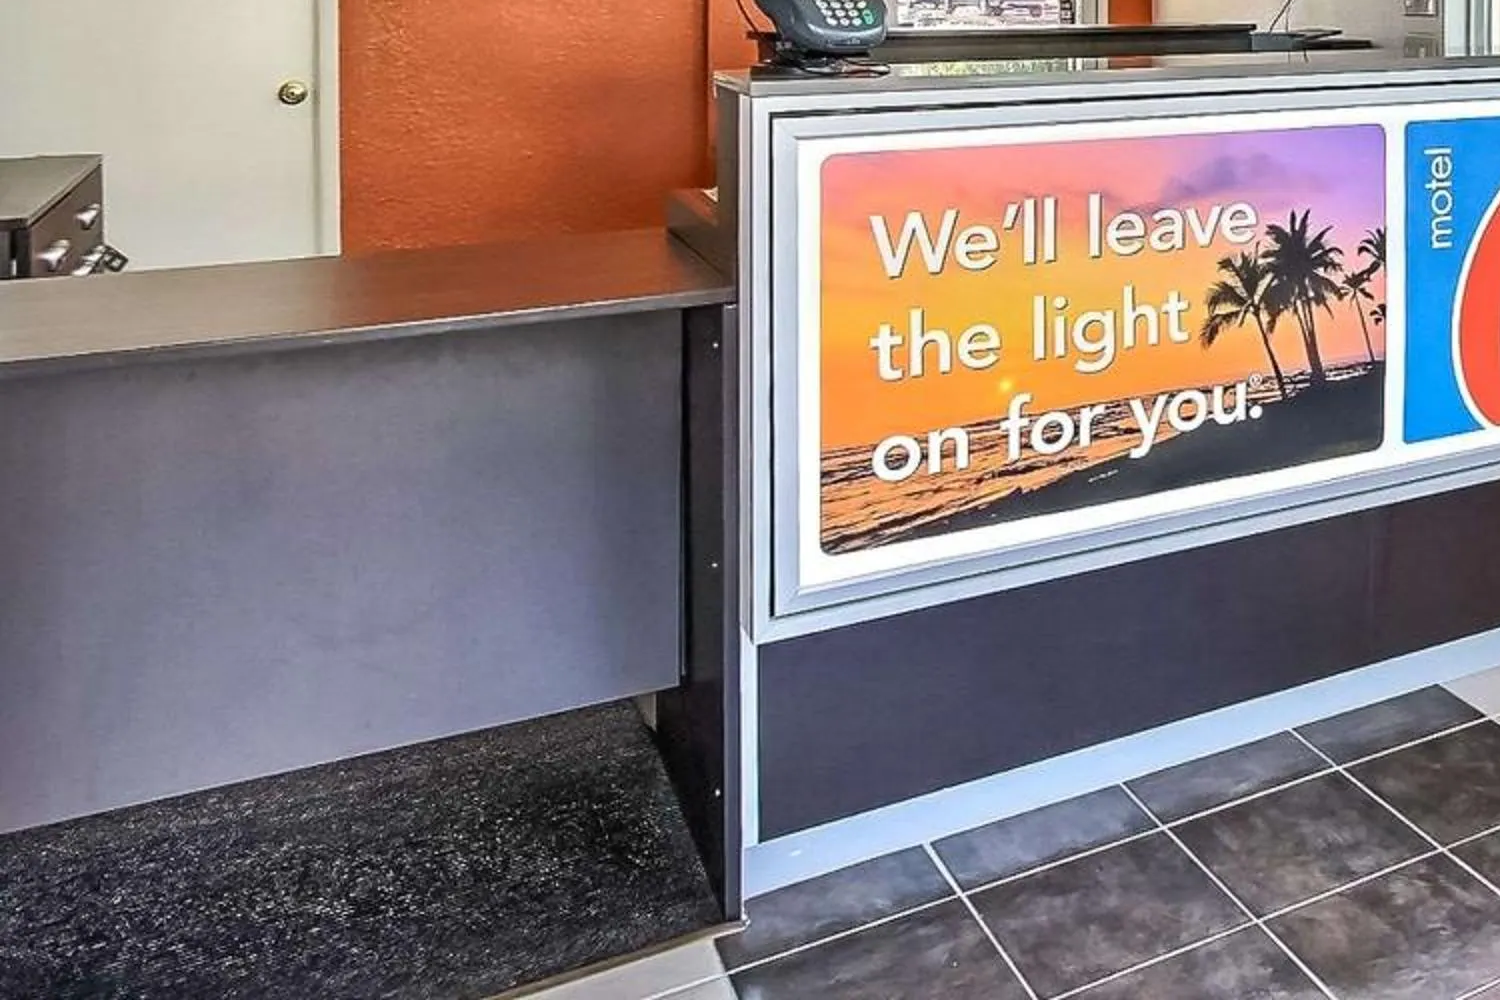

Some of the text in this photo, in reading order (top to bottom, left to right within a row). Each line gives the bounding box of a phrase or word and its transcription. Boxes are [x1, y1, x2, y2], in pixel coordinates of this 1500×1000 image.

[869, 192, 1260, 279] We'll leave
[1424, 147, 1453, 249] motel
[869, 282, 1191, 382] the light
[871, 423, 971, 483] on
[1000, 391, 1107, 462] for
